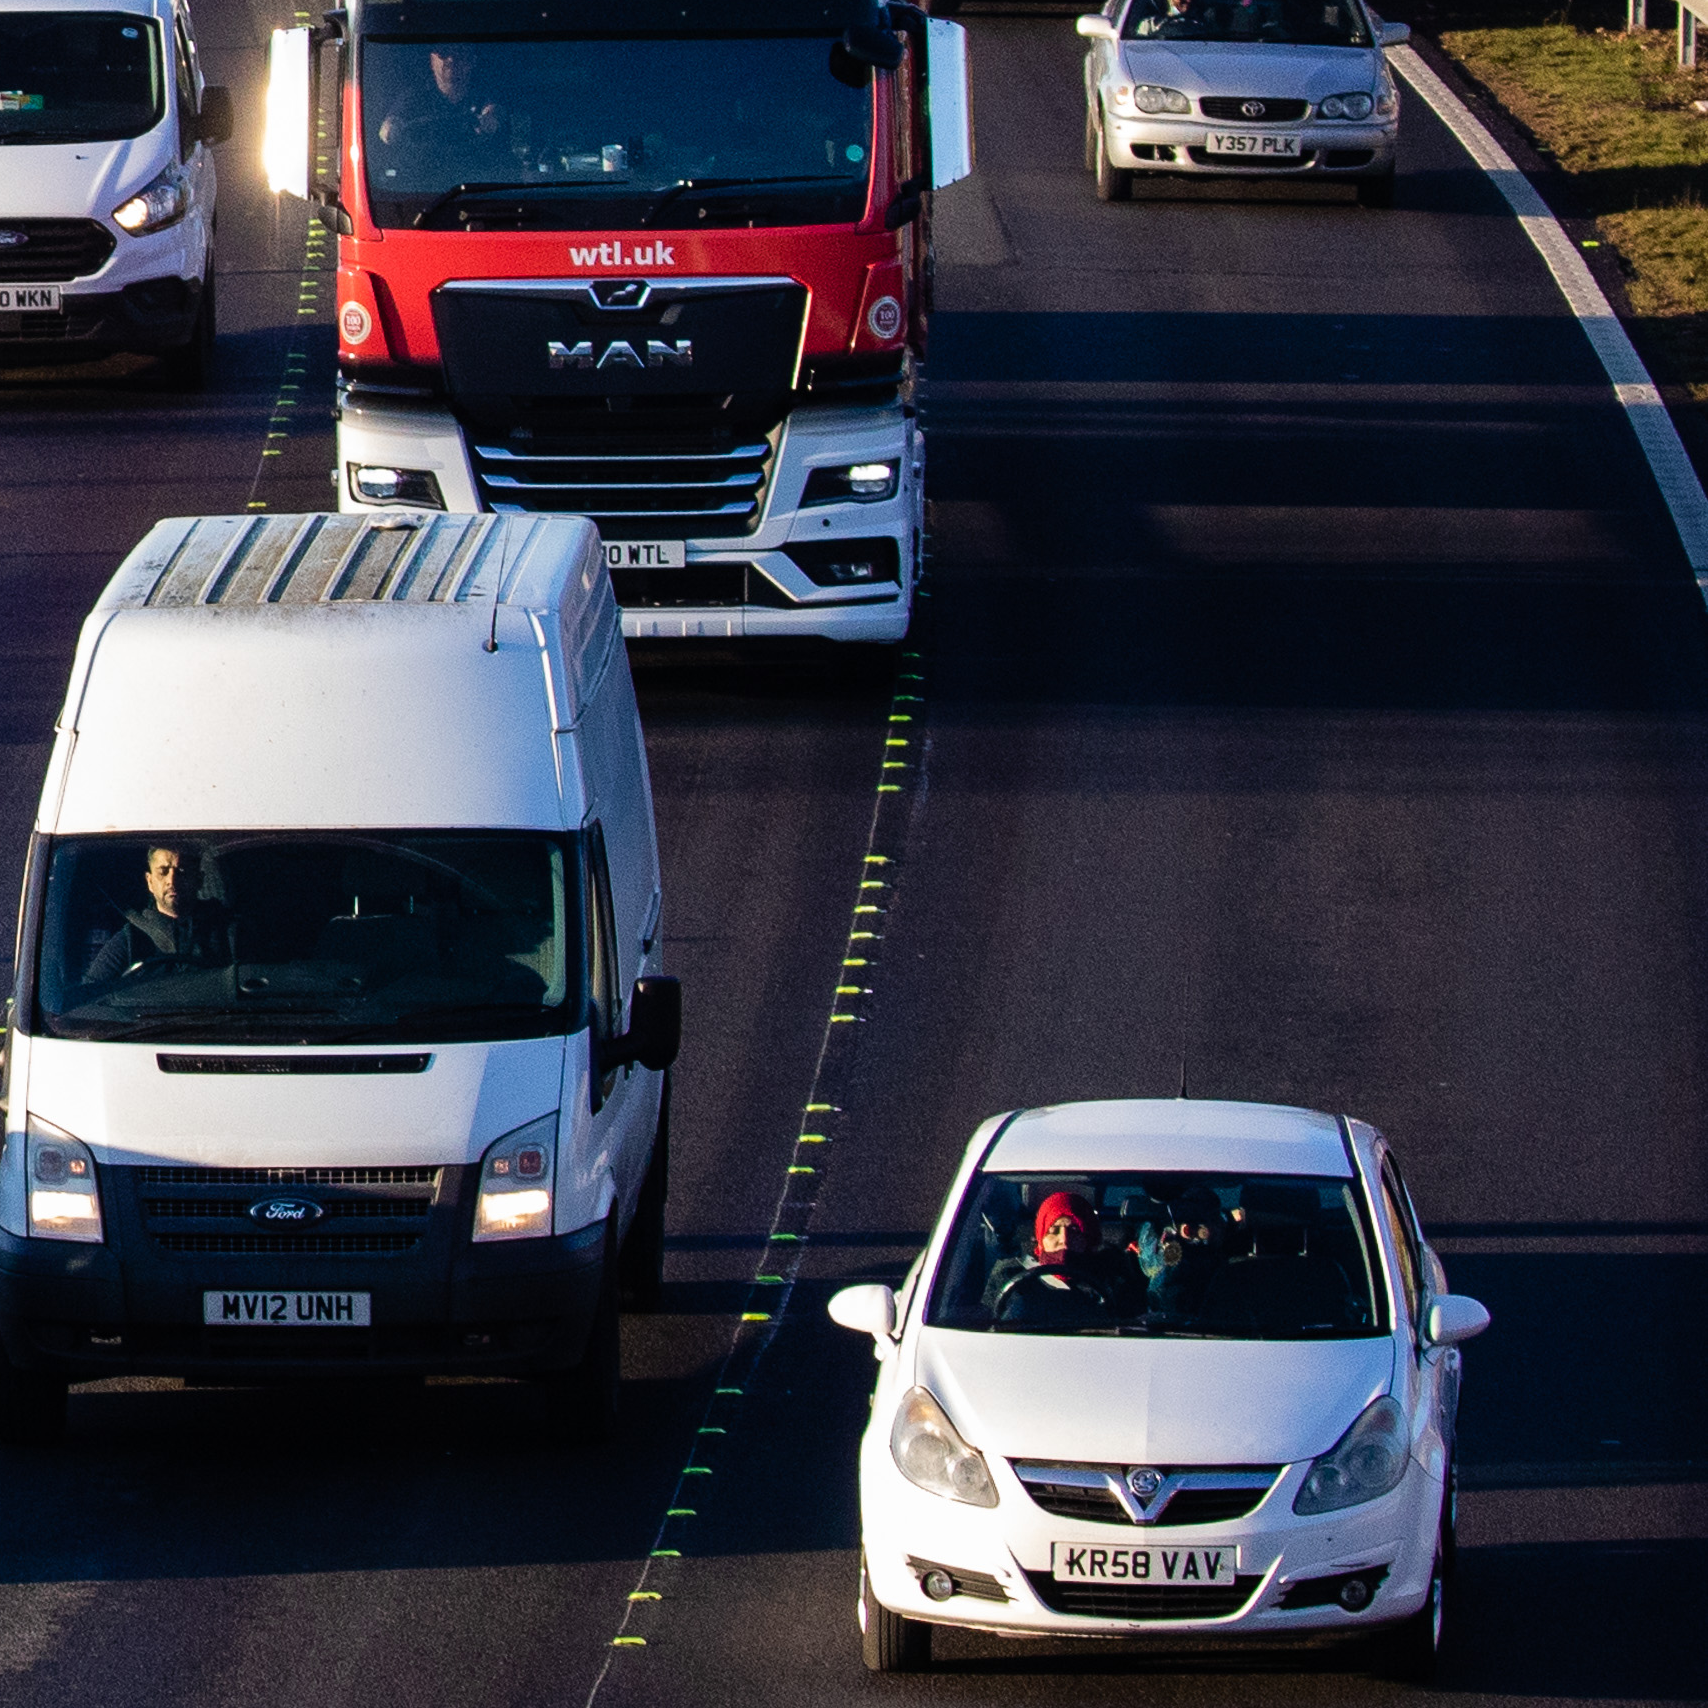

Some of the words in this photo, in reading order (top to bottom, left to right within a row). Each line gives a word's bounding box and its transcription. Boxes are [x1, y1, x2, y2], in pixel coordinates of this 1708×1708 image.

[1214, 135, 1258, 152] Y357
[1261, 136, 1295, 154] PLK
[568, 240, 675, 267] wtl.uk
[15, 289, 52, 307] WKN
[547, 339, 693, 369] MAN
[628, 544, 670, 565] WTL
[265, 1202, 306, 1220] Ford
[222, 1294, 288, 1321] MV12
[296, 1294, 353, 1321] UNH
[1068, 1547, 1151, 1579] KR58
[1161, 1550, 1222, 1580] VAV
